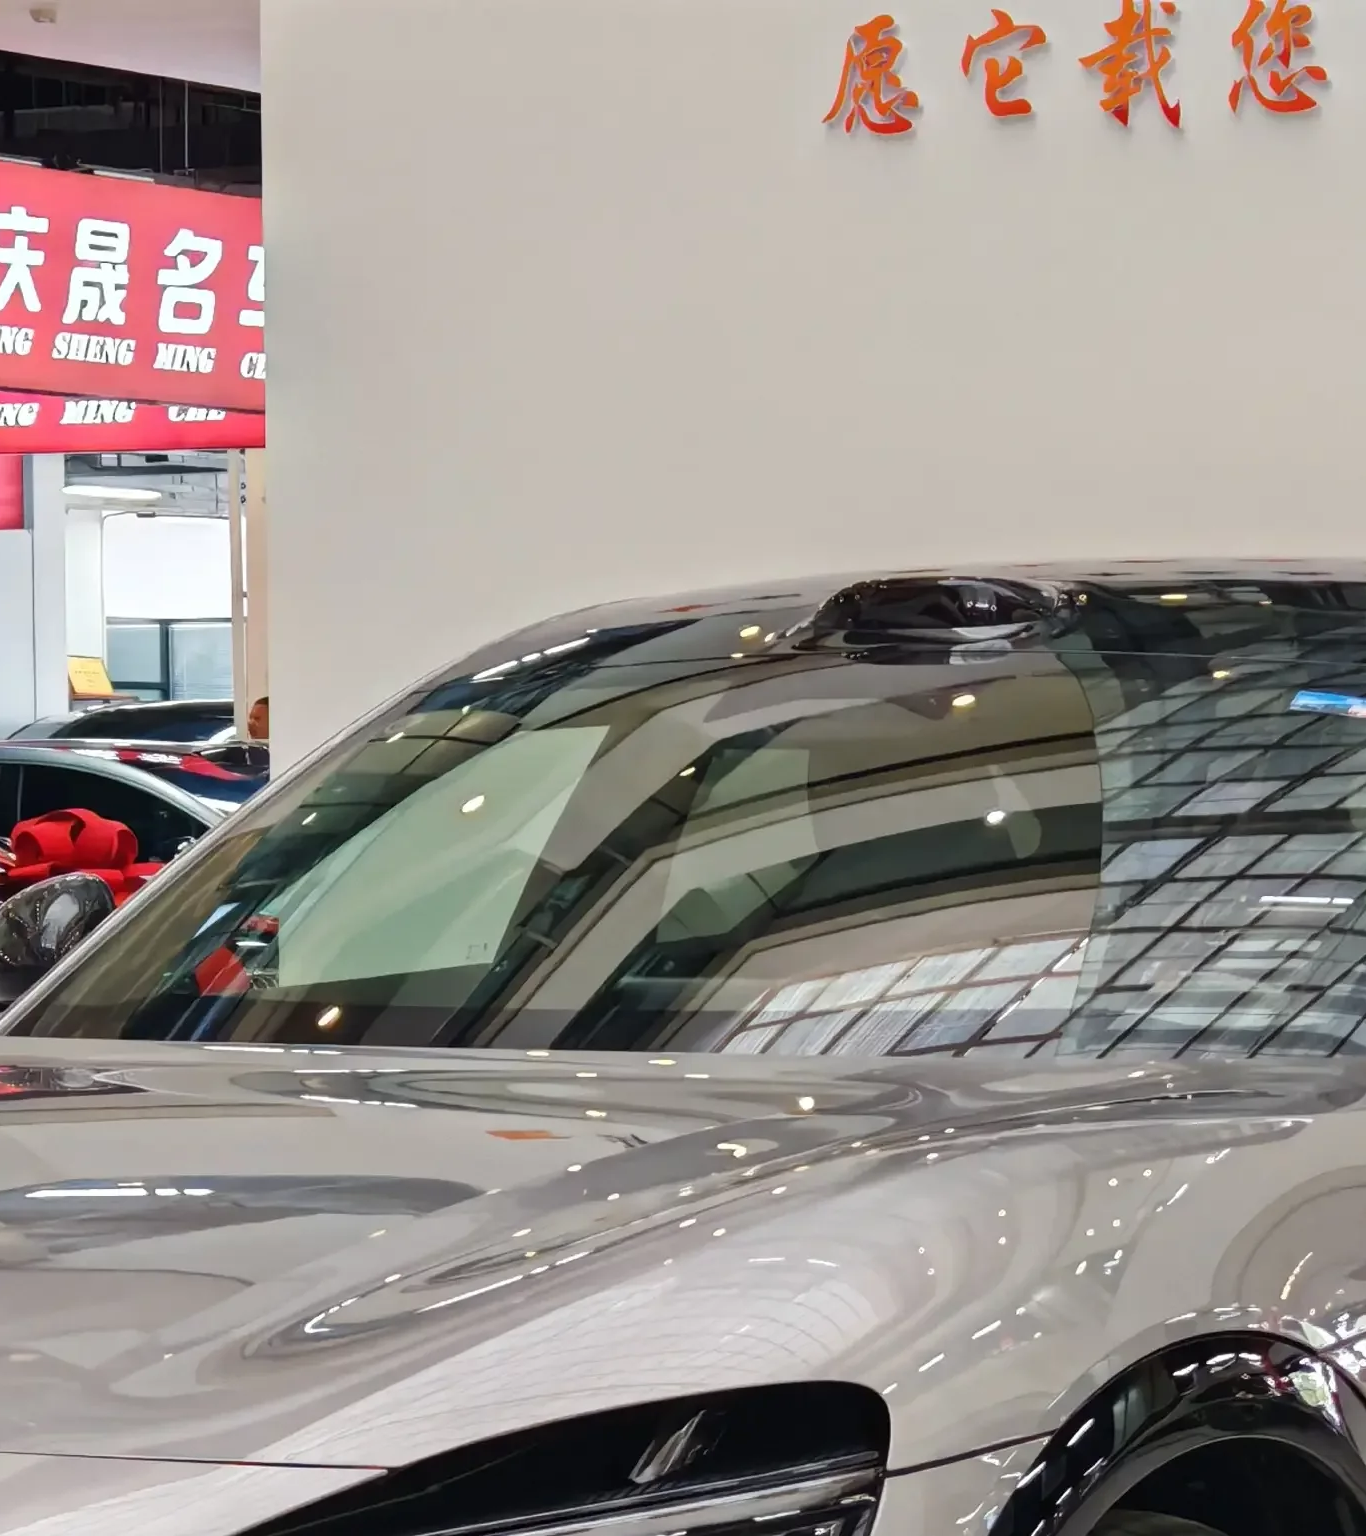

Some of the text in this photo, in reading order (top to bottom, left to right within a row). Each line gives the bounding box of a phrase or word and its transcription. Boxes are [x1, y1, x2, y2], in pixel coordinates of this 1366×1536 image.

[52, 331, 136, 366] SHENG
[153, 342, 217, 373] MING
[60, 400, 137, 425] MING
